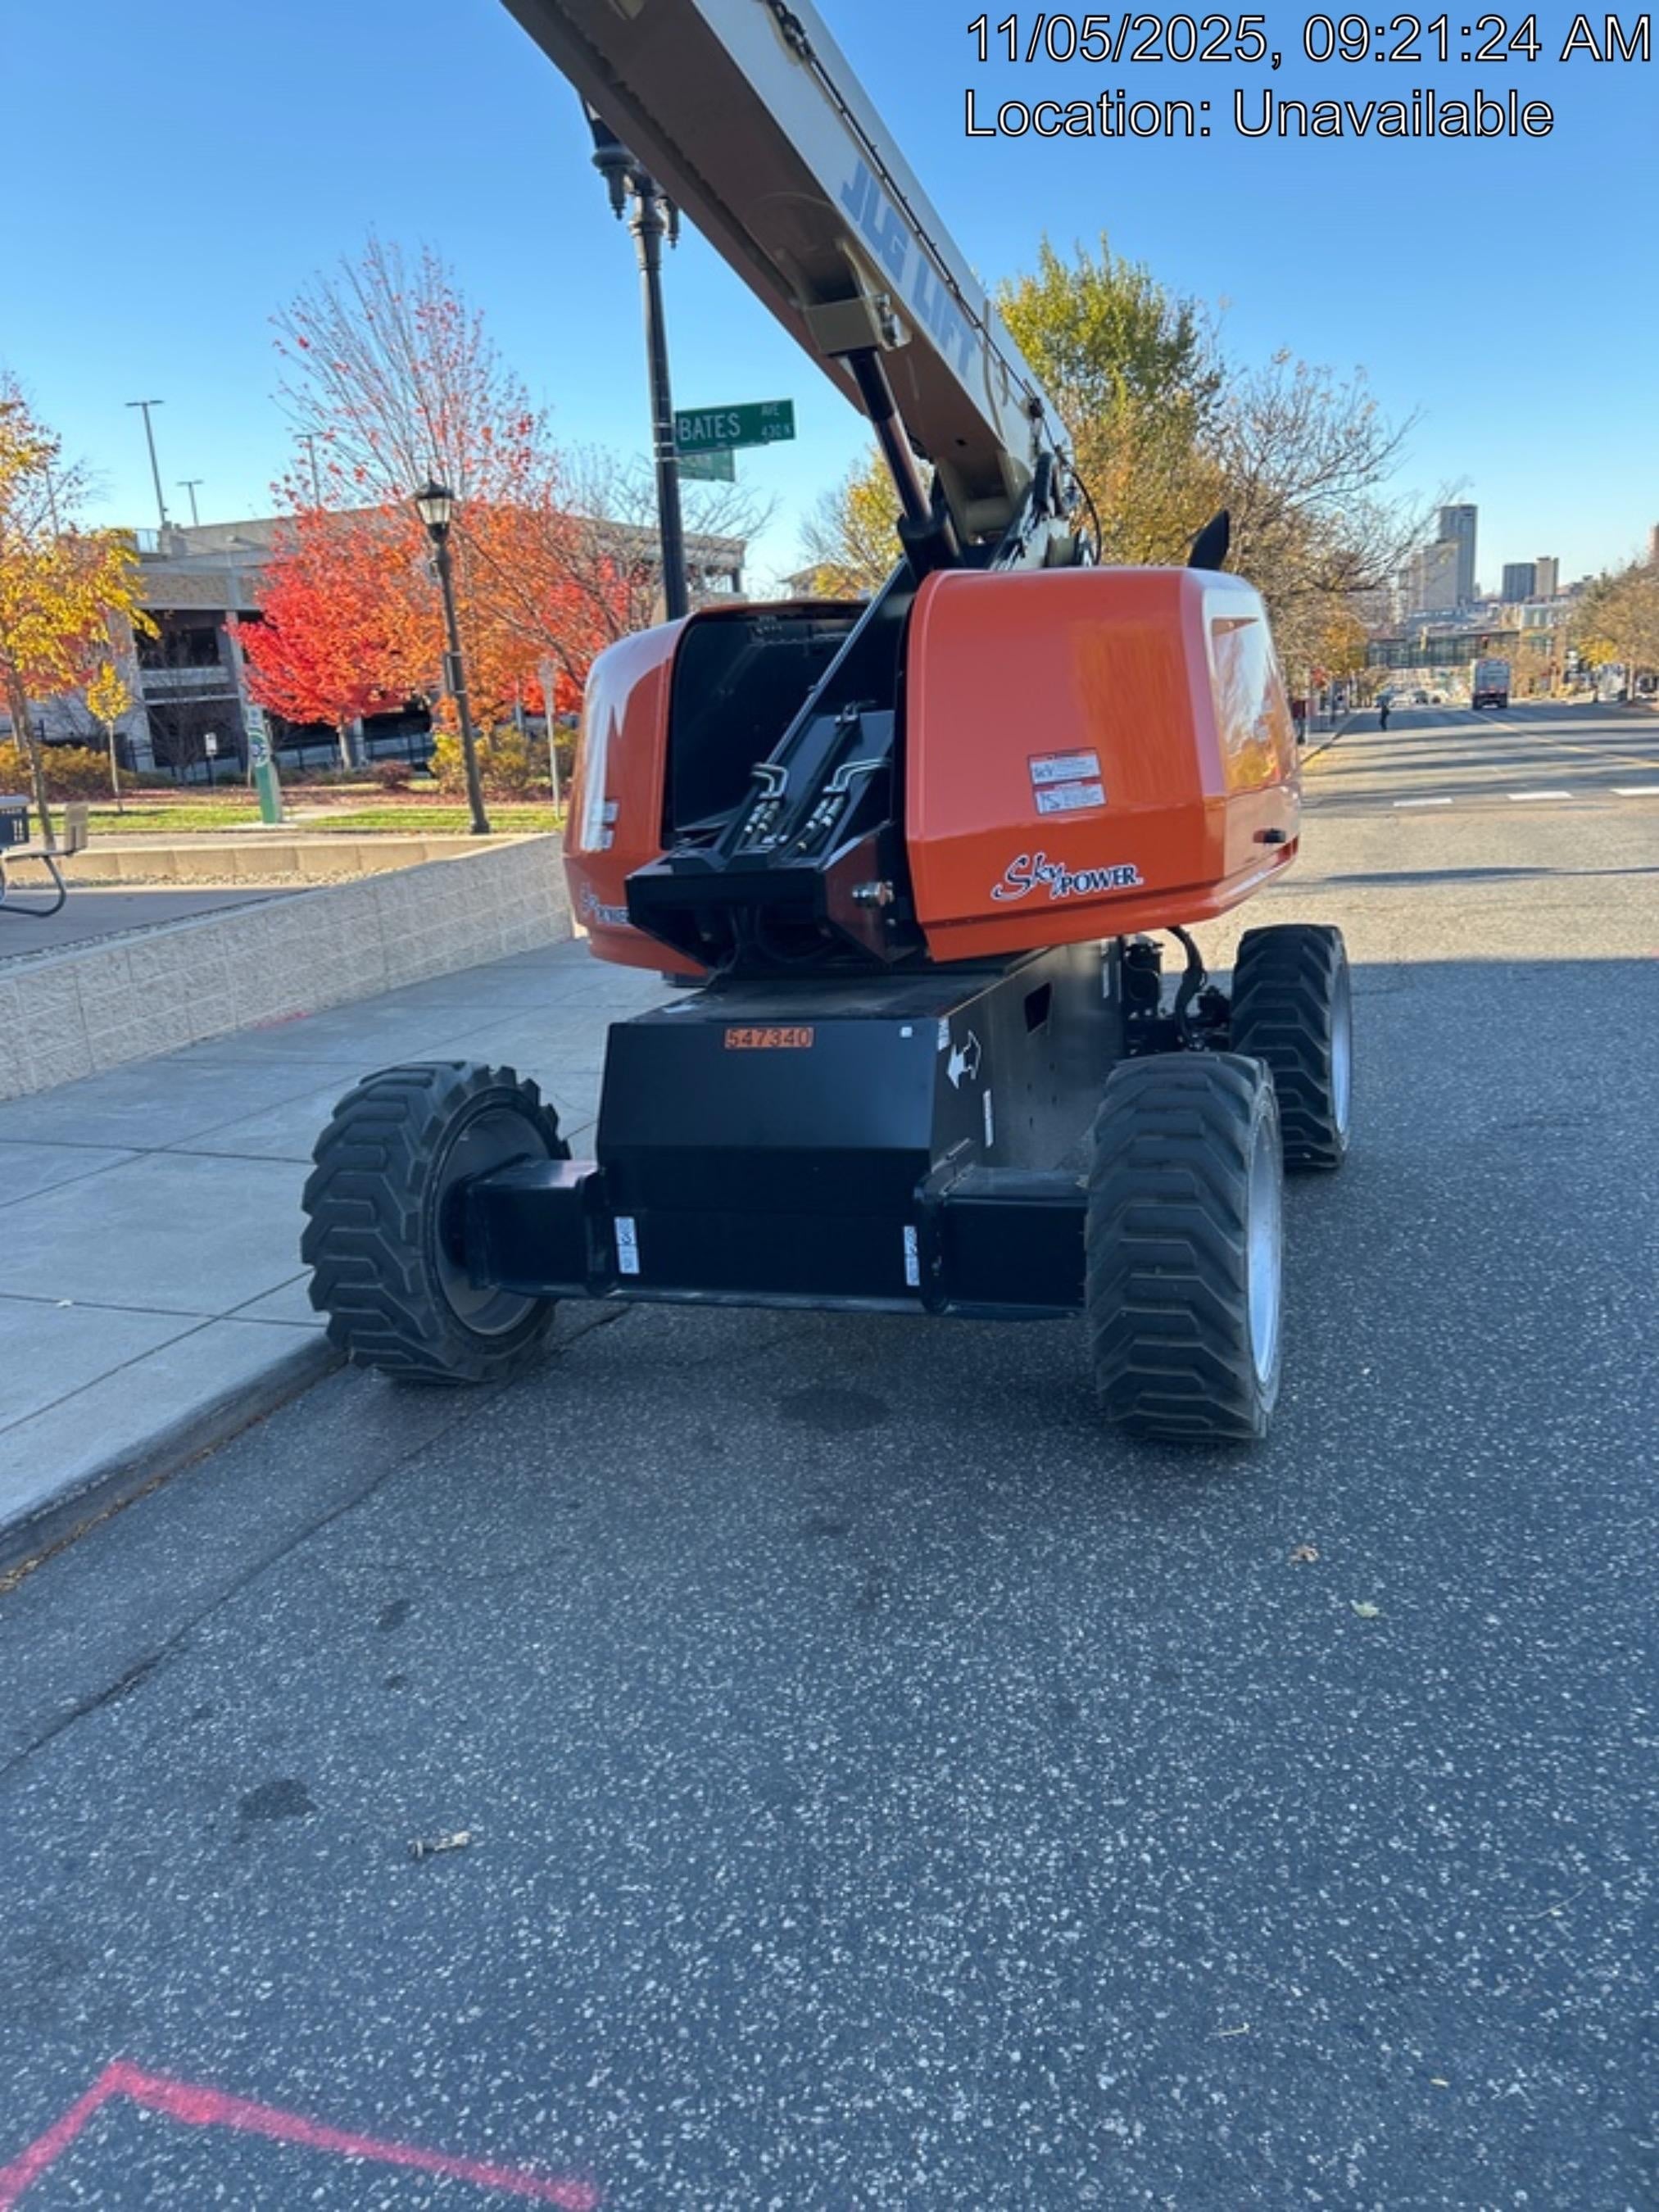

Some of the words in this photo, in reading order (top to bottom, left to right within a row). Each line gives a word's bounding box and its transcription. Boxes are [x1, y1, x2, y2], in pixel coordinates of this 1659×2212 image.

[841, 159, 910, 284] JLG
[678, 413, 741, 442] BATES
[726, 1028, 811, 1048] 547340
